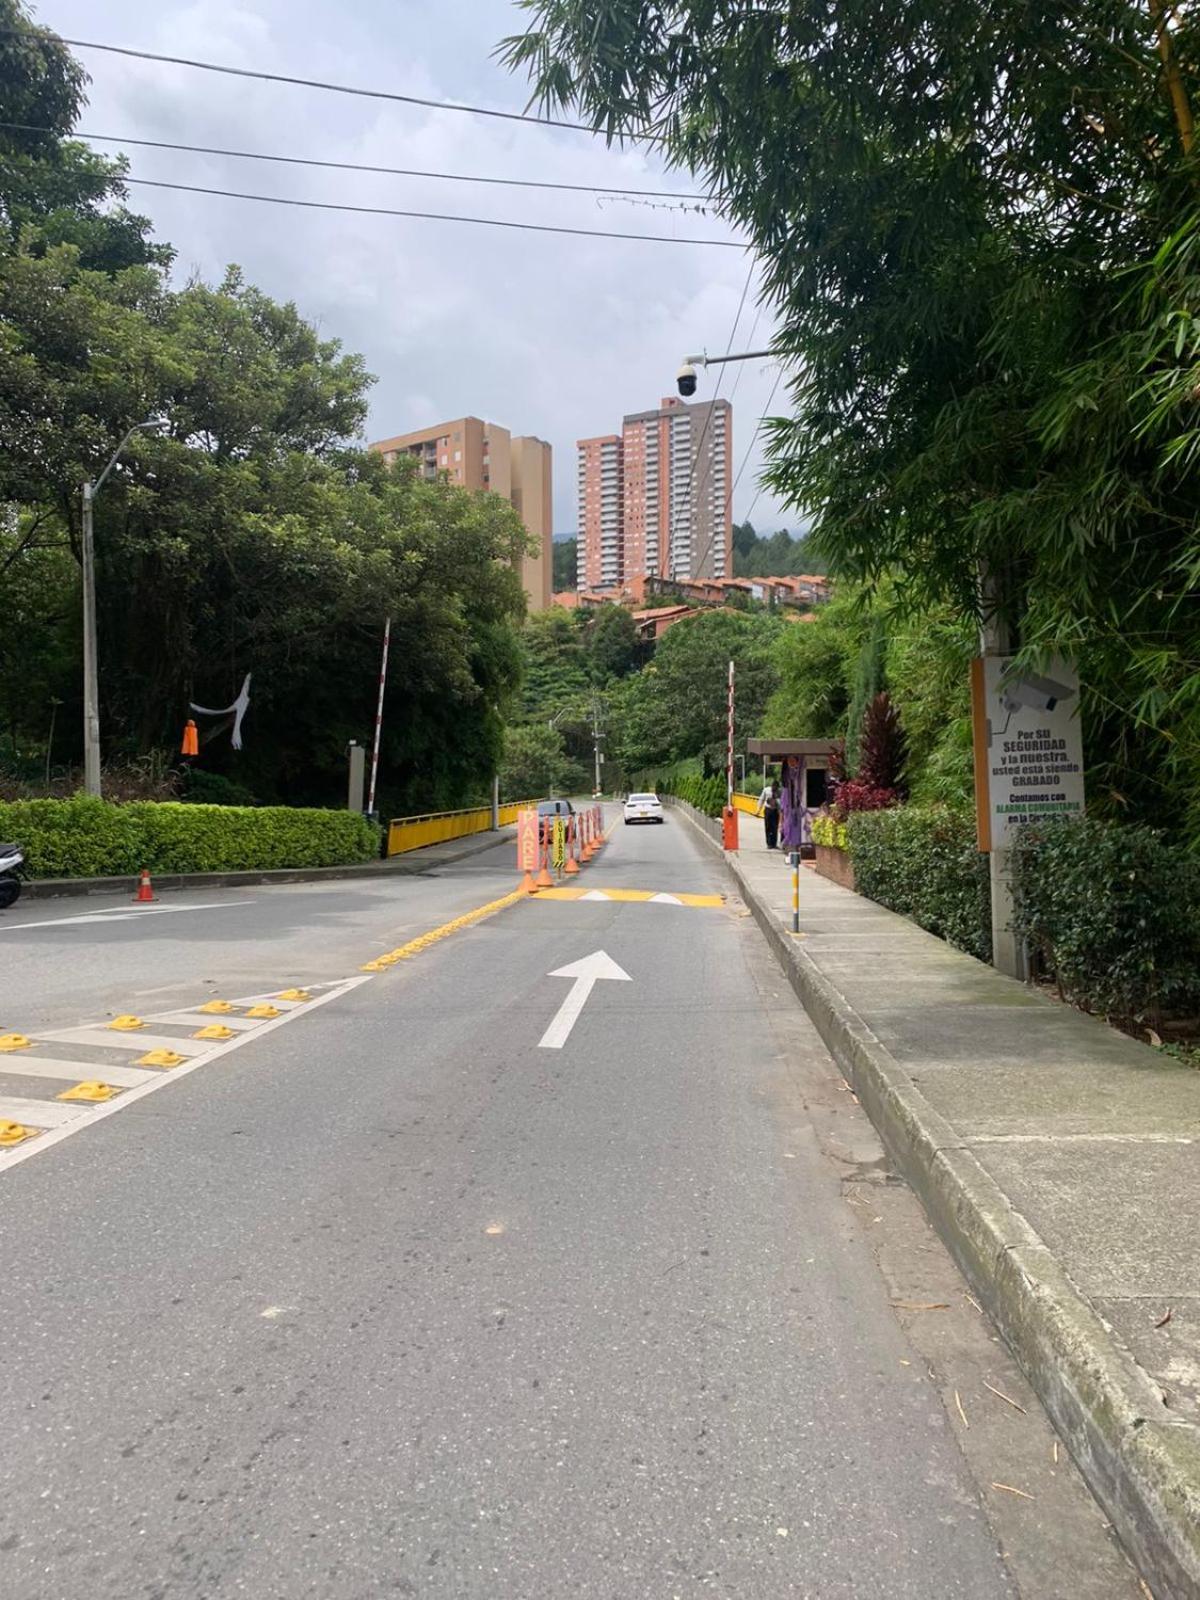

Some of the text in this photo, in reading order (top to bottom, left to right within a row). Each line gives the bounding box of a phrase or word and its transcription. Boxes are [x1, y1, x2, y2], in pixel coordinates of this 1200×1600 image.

[1017, 729, 1051, 740] Por SU
[1003, 739, 1066, 752] SEGURIDAD
[1001, 756, 1007, 765] y
[1008, 755, 1018, 764] la
[992, 766, 1020, 775] usted
[1045, 763, 1079, 773] siendo
[1012, 775, 1060, 787] GRABADO
[1009, 793, 1066, 803] Contamos con
[996, 804, 1027, 813] ALARMA
[1008, 815, 1018, 823] en
[1019, 814, 1027, 823] la
[522, 811, 535, 870] PARE
